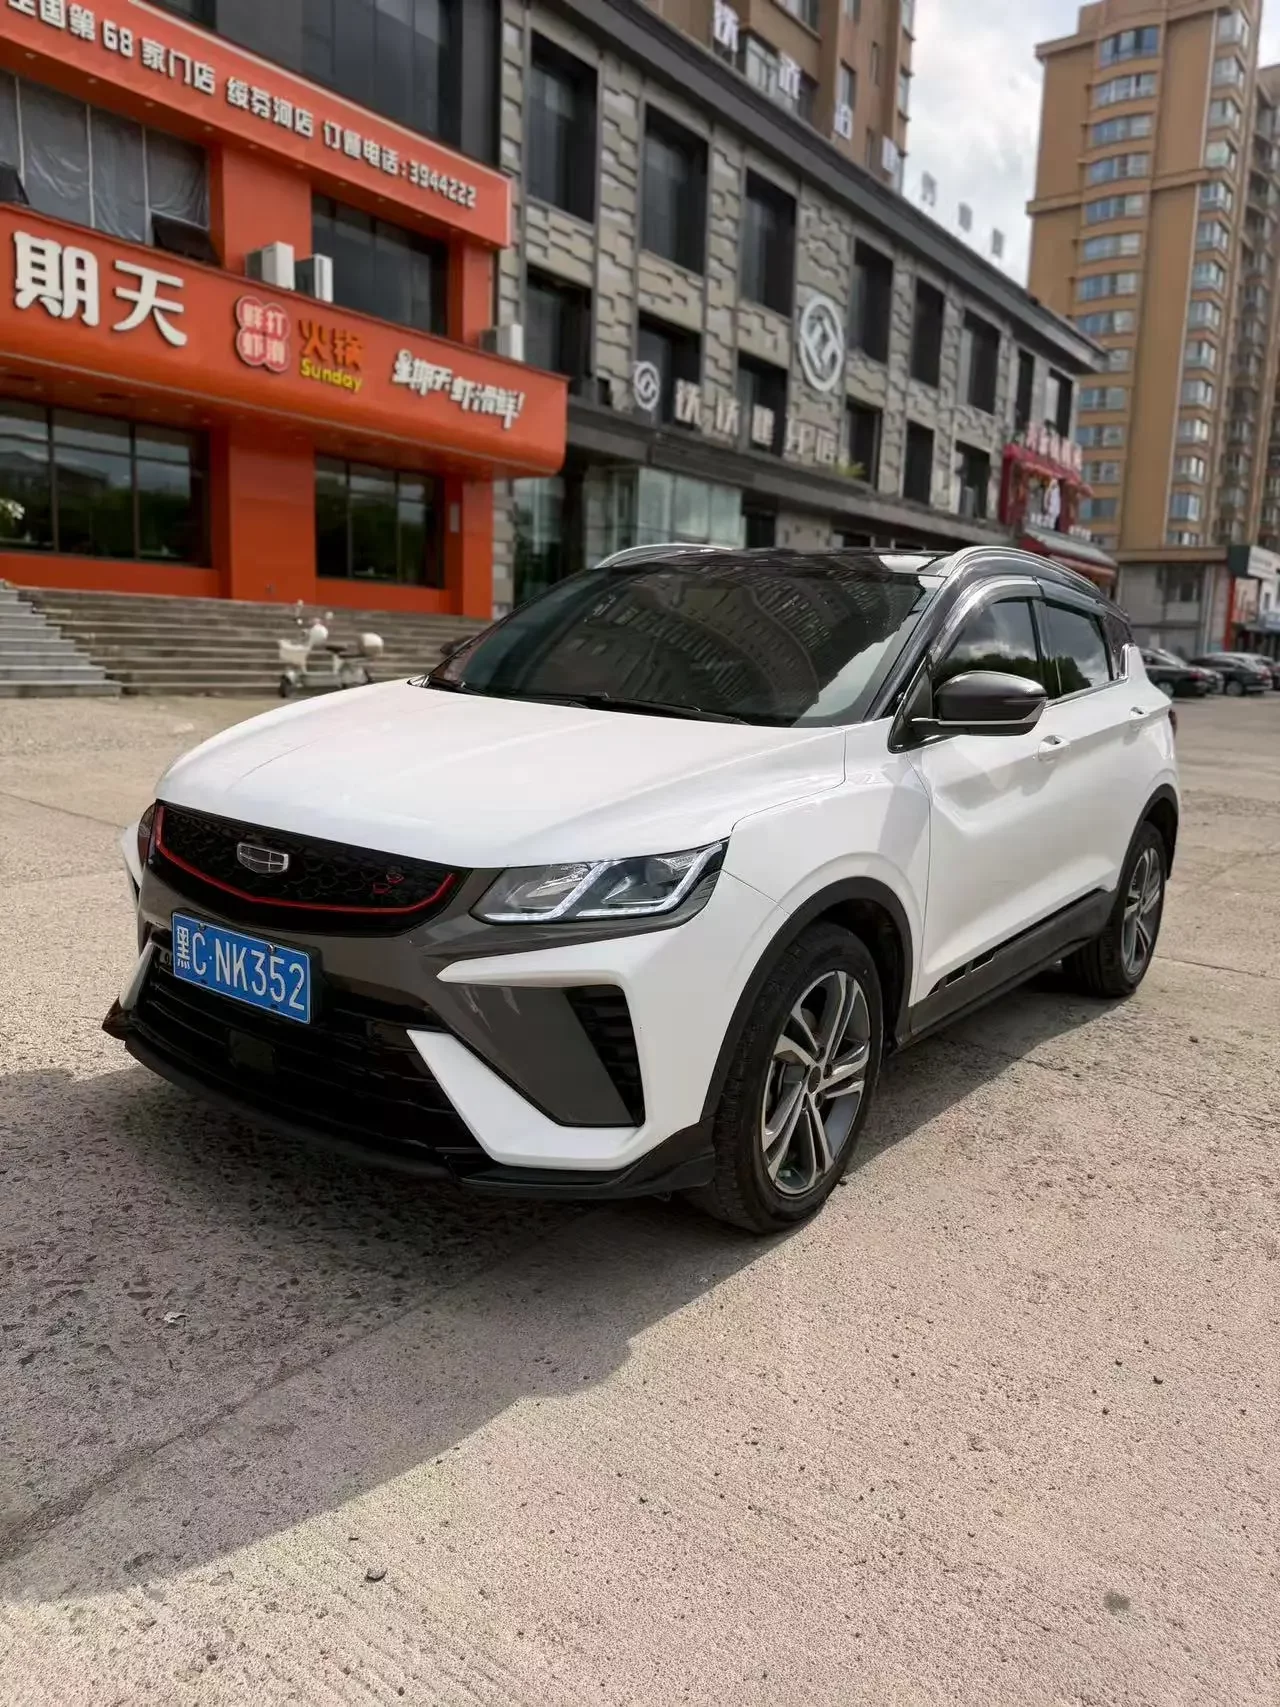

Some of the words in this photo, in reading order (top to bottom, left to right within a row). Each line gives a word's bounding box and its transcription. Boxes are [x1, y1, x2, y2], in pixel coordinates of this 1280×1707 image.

[103, 19, 133, 57] 68
[142, 37, 216, 95] 家门店
[14, 231, 188, 347] 期天
[301, 357, 362, 393] Sunday
